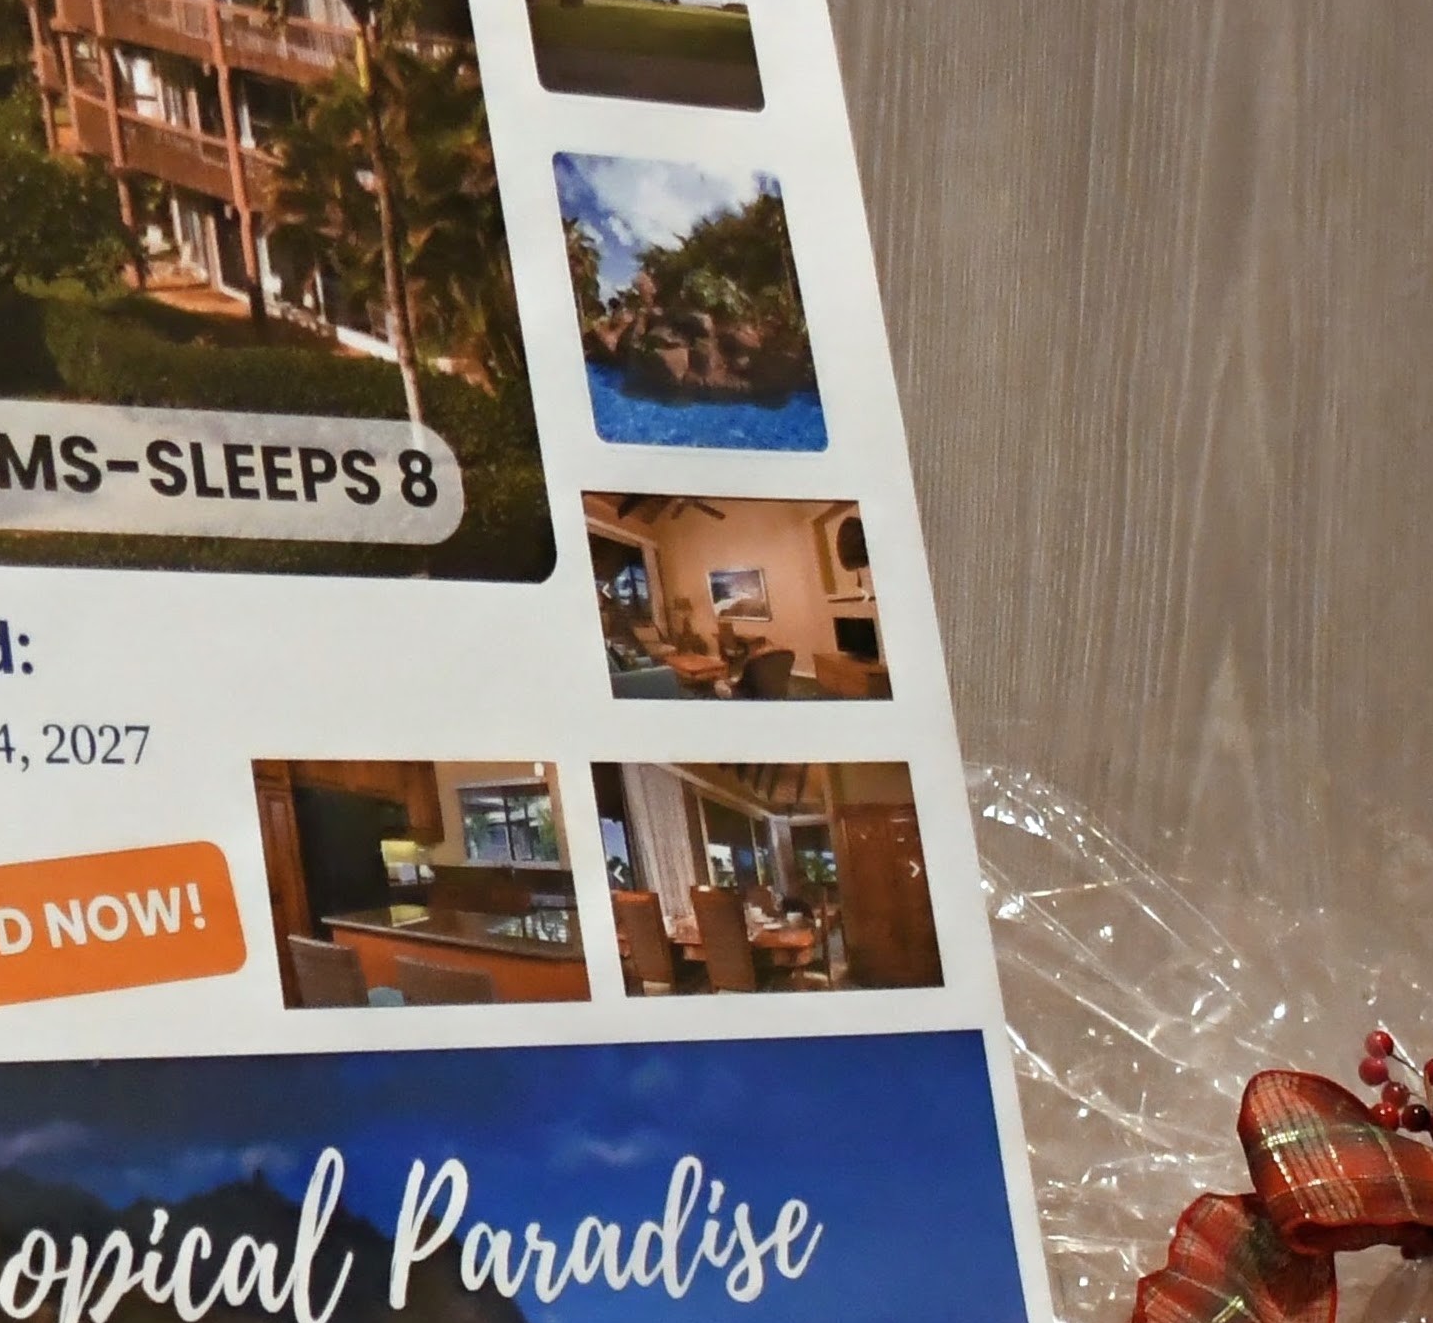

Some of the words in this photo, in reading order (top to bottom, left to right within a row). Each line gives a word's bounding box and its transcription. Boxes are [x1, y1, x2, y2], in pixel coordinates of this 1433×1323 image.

[398, 449, 439, 511] 8
[42, 723, 151, 766] 2027
[46, 879, 208, 950] NOW!
[386, 1155, 824, 1311] Paradise
